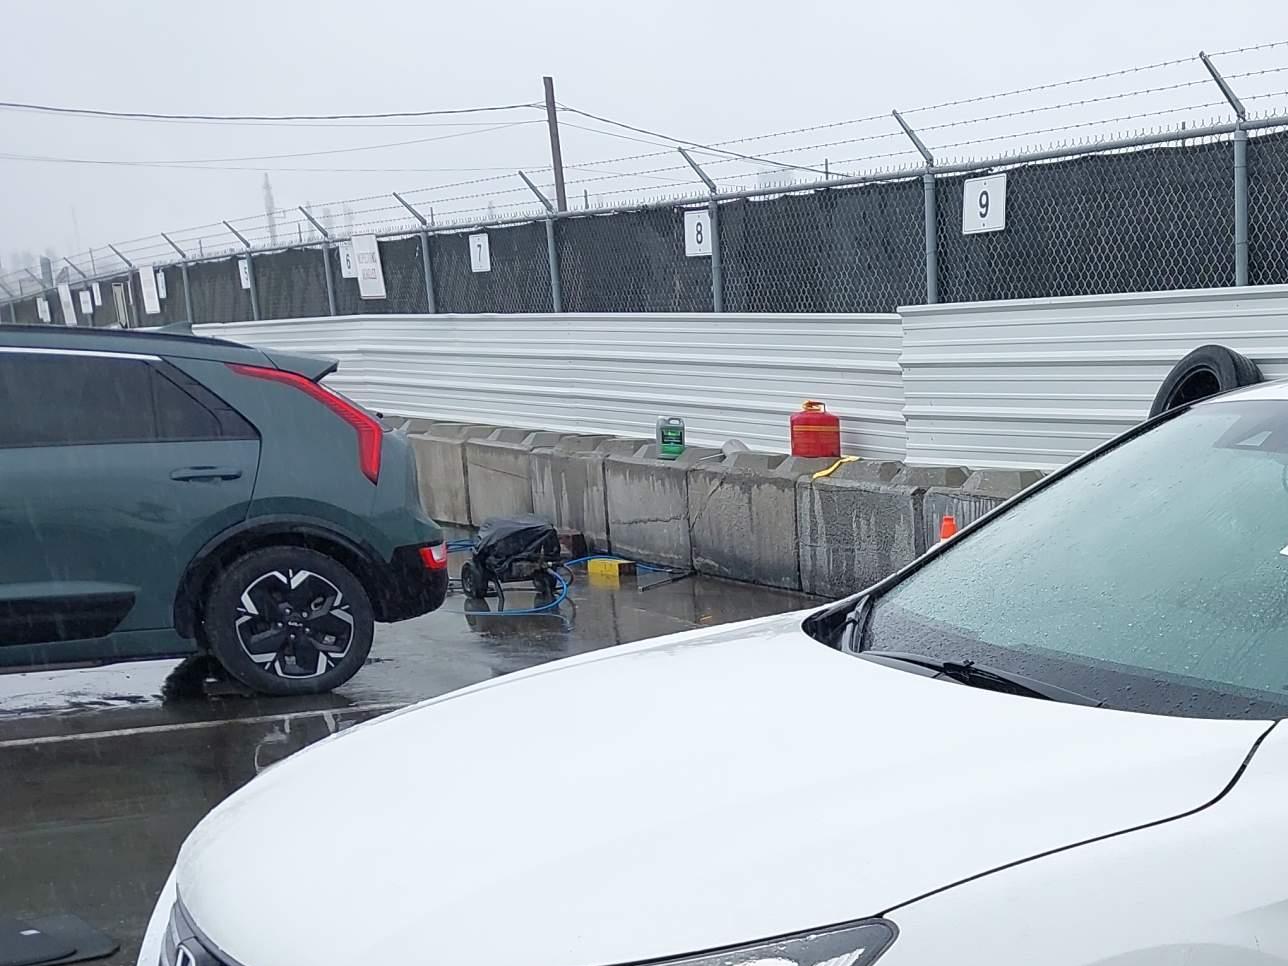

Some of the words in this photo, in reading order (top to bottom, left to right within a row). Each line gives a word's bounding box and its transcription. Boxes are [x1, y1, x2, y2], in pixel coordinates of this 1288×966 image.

[978, 190, 989, 218] 9
[695, 221, 703, 245] 8
[345, 253, 351, 269] 6
[477, 243, 483, 262] 7
